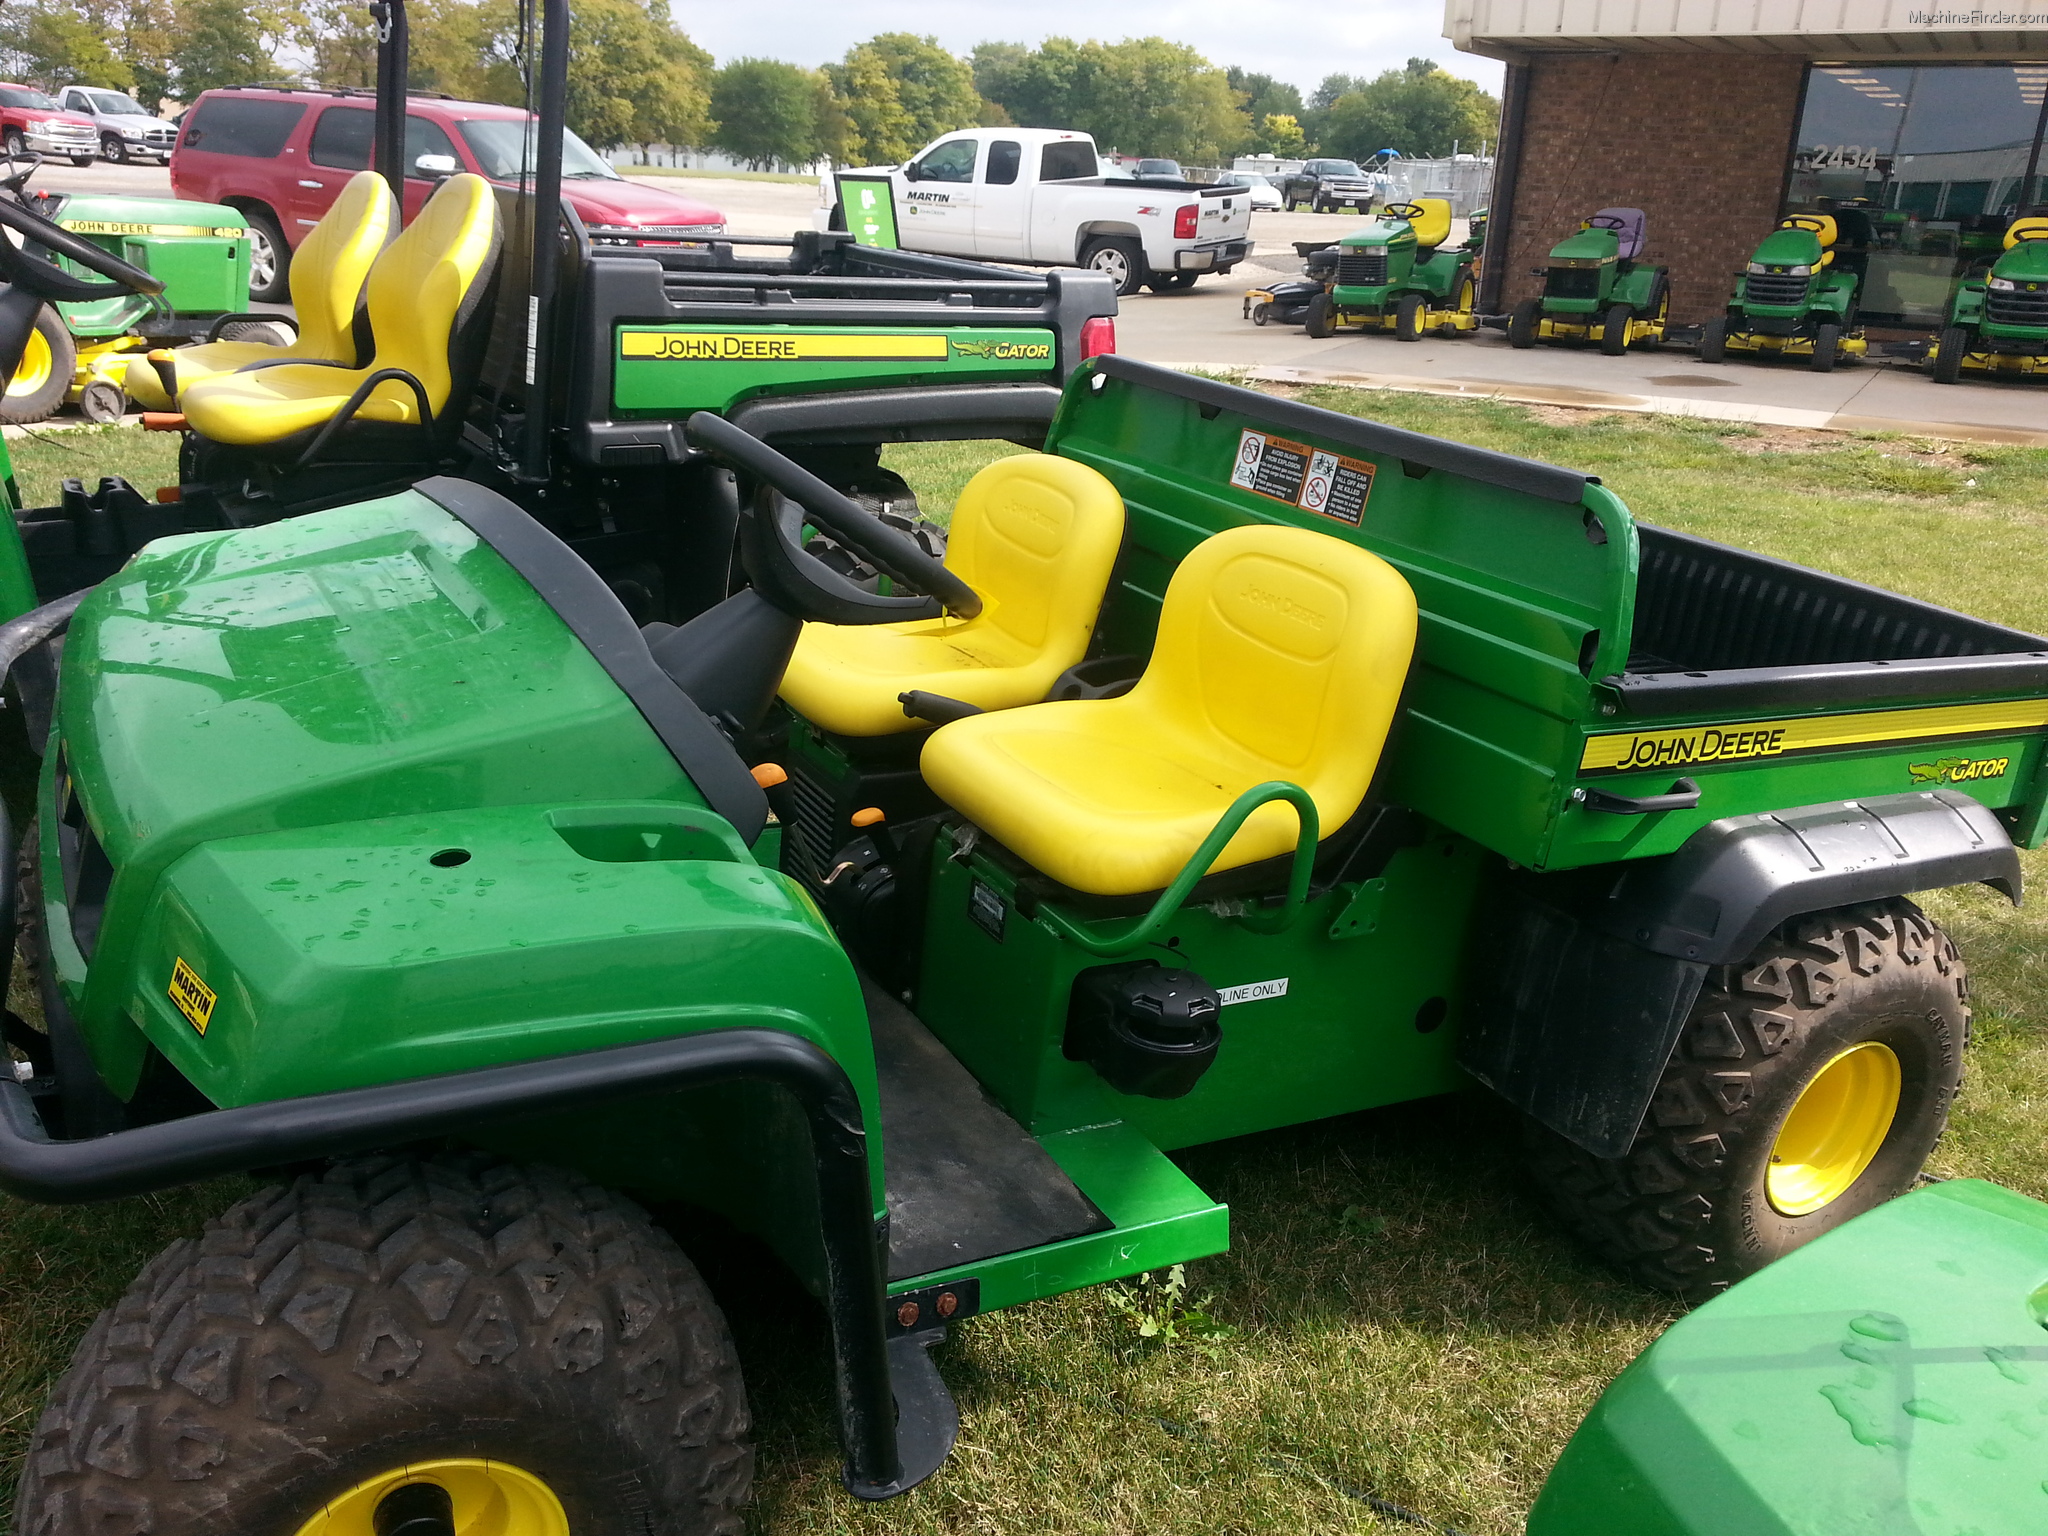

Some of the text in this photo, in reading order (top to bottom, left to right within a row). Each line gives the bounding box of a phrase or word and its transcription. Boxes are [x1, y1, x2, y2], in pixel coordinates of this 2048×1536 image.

[1811, 144, 1877, 170] 2434
[907, 191, 950, 202] MARTIN
[71, 221, 242, 238] JOHN DEERE 420
[655, 336, 796, 356] JOHN DEERE
[995, 342, 1050, 359] GATOR
[1278, 439, 1304, 453] WARNING
[1345, 459, 1374, 473] WARNING
[1335, 475, 1346, 483] FALL
[1356, 482, 1367, 490] AND
[1356, 474, 1367, 482] CAN
[1336, 483, 1360, 496] BE KILLED
[1617, 729, 1786, 766] JOHN DEERE
[1951, 758, 2009, 781] GATOR
[173, 966, 210, 1016] MARTIN
[1252, 981, 1286, 997] ONLY
[1925, 1007, 1953, 1067] CAYMAN
